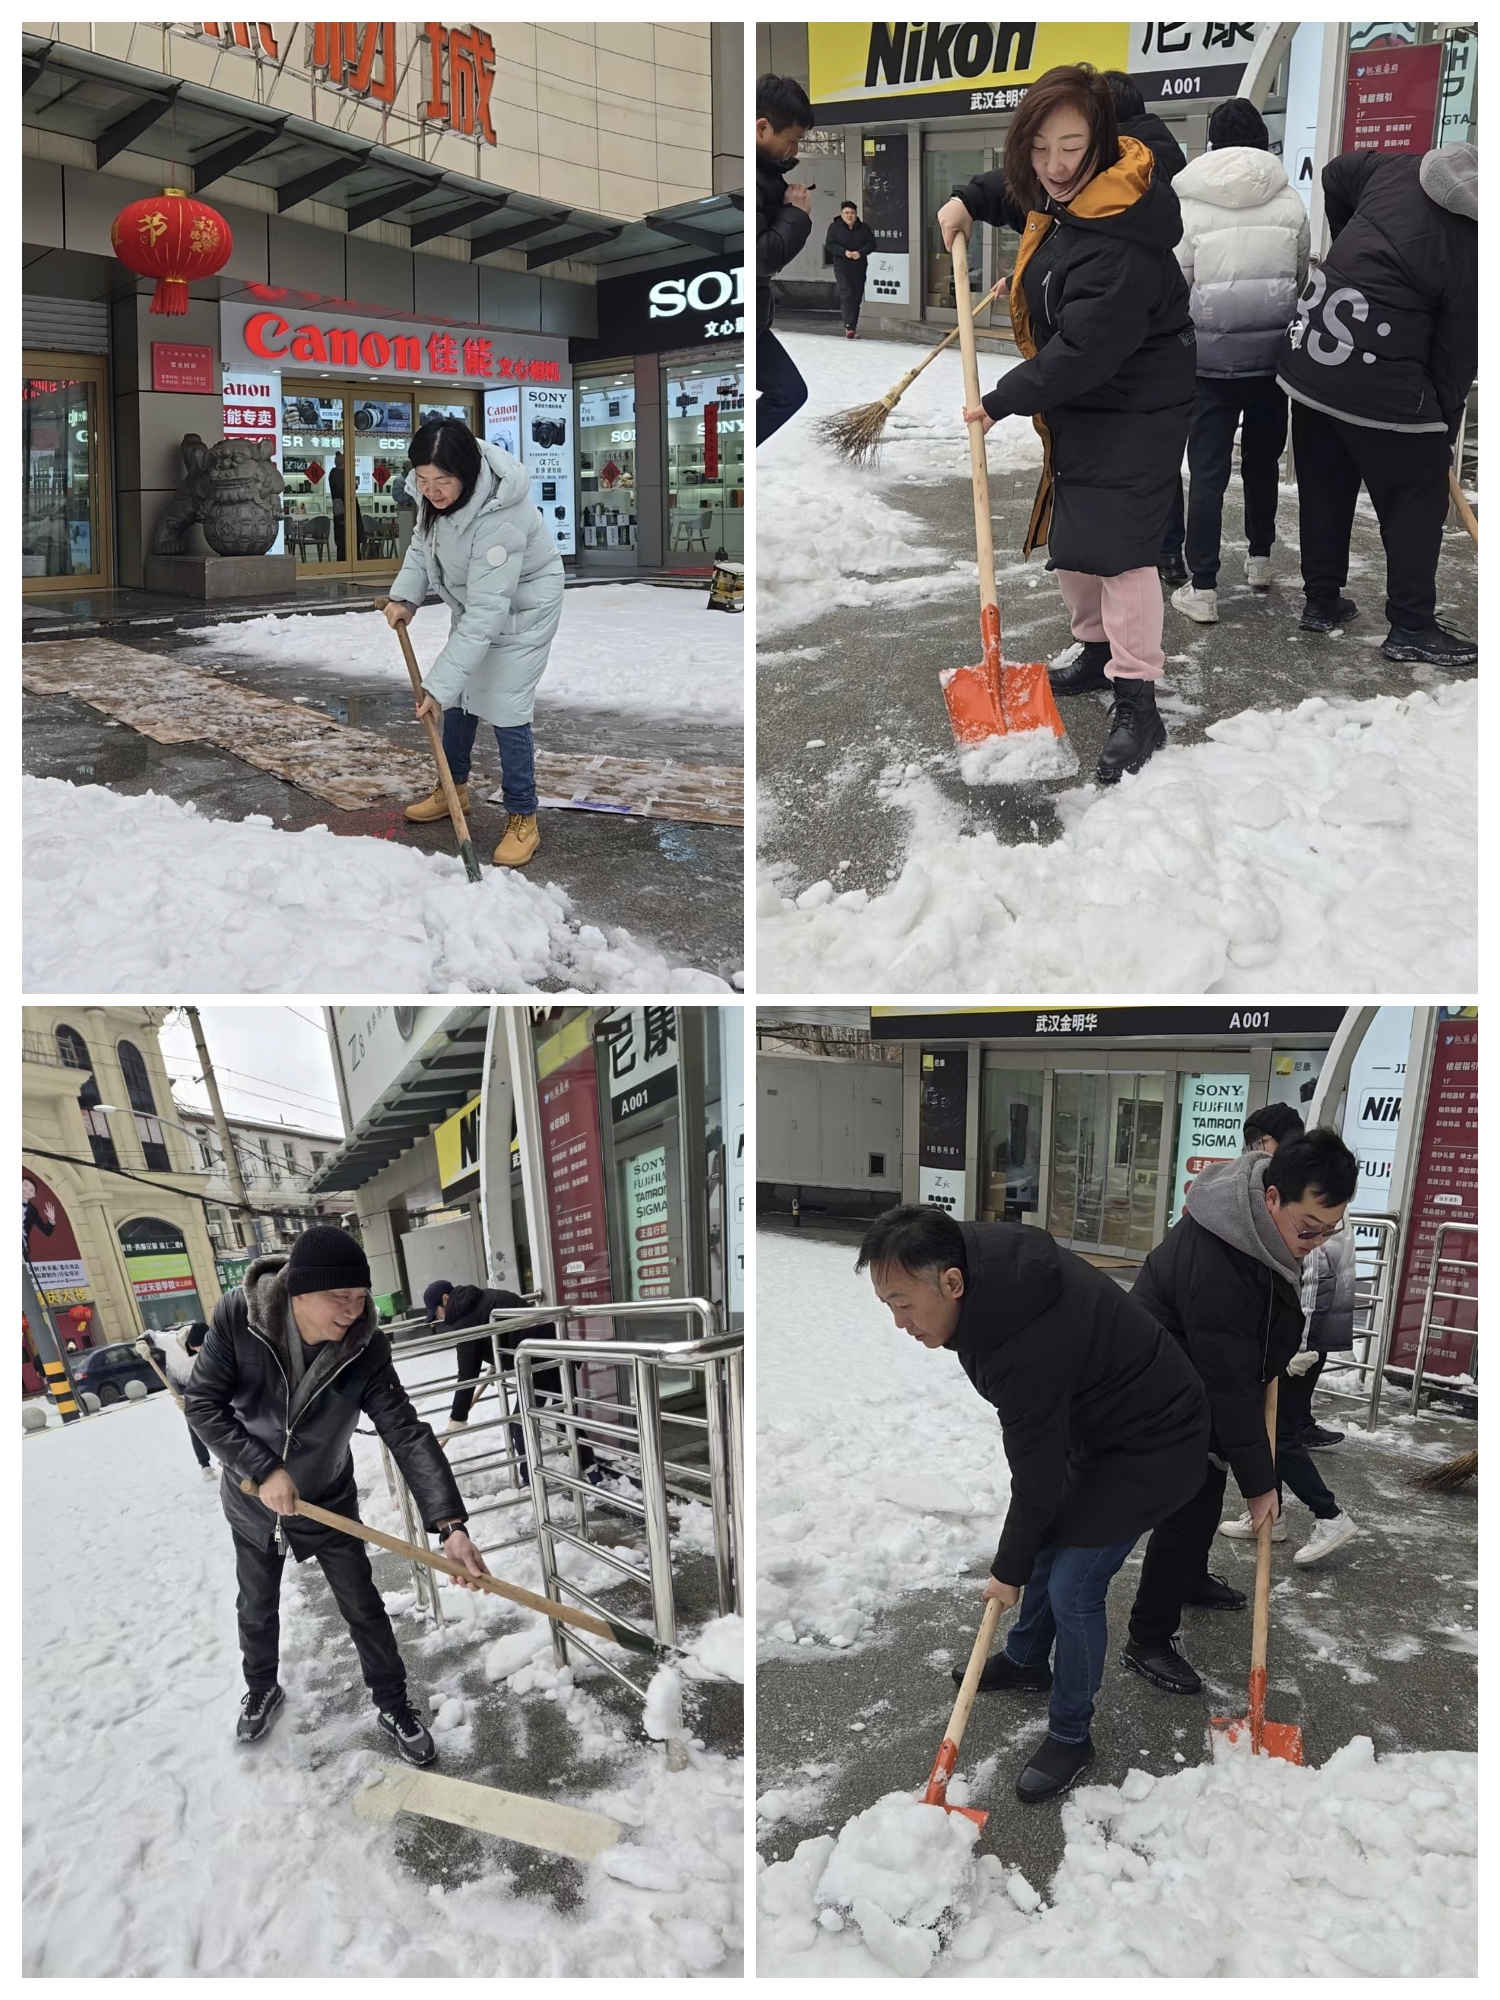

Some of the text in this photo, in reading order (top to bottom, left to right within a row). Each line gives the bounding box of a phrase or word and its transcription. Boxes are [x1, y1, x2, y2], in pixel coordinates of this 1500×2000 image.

[864, 22, 1038, 88] Nikon
[1161, 76, 1202, 96] A001
[1359, 92, 1392, 104] 楼层指引
[1386, 123, 1412, 132] 影视器材
[1384, 139, 1410, 147] 数码冲印
[136, 211, 168, 247] 节
[649, 266, 744, 319] SO
[244, 312, 562, 382] Canon 佳能 文心相机
[528, 391, 568, 402] SONY
[487, 404, 518, 416] Canon
[697, 419, 744, 436] SNY
[310, 436, 343, 448] 专微相
[379, 437, 406, 450] EOS
[1035, 1013, 1098, 1033] 武汉金明华
[1229, 1011, 1270, 1029] A001
[1293, 1061, 1312, 1071] 尼康
[1446, 1061, 1478, 1071] 楼层指引
[1195, 1084, 1243, 1096] SONY
[621, 1089, 648, 1116] A001
[1192, 1101, 1243, 1113] FUJIFILM
[1192, 1117, 1241, 1129] TAMRON
[1436, 1120, 1460, 1128] 彩妆饰品
[1192, 1133, 1237, 1148] SIGMA
[1431, 1151, 1455, 1159] 婚纱礼服
[1429, 1164, 1478, 1174] 儿童服饰 演出服
[1427, 1178, 1451, 1186] 民族汉服
[636, 1201, 667, 1218] SIGMA
[639, 1224, 667, 1239] 正品行货
[640, 1245, 668, 1258] 回收置换
[641, 1266, 669, 1278] 政府采购
[642, 1286, 669, 1297] 出租维修
[1402, 1342, 1458, 1359] 武汉纱照材城
